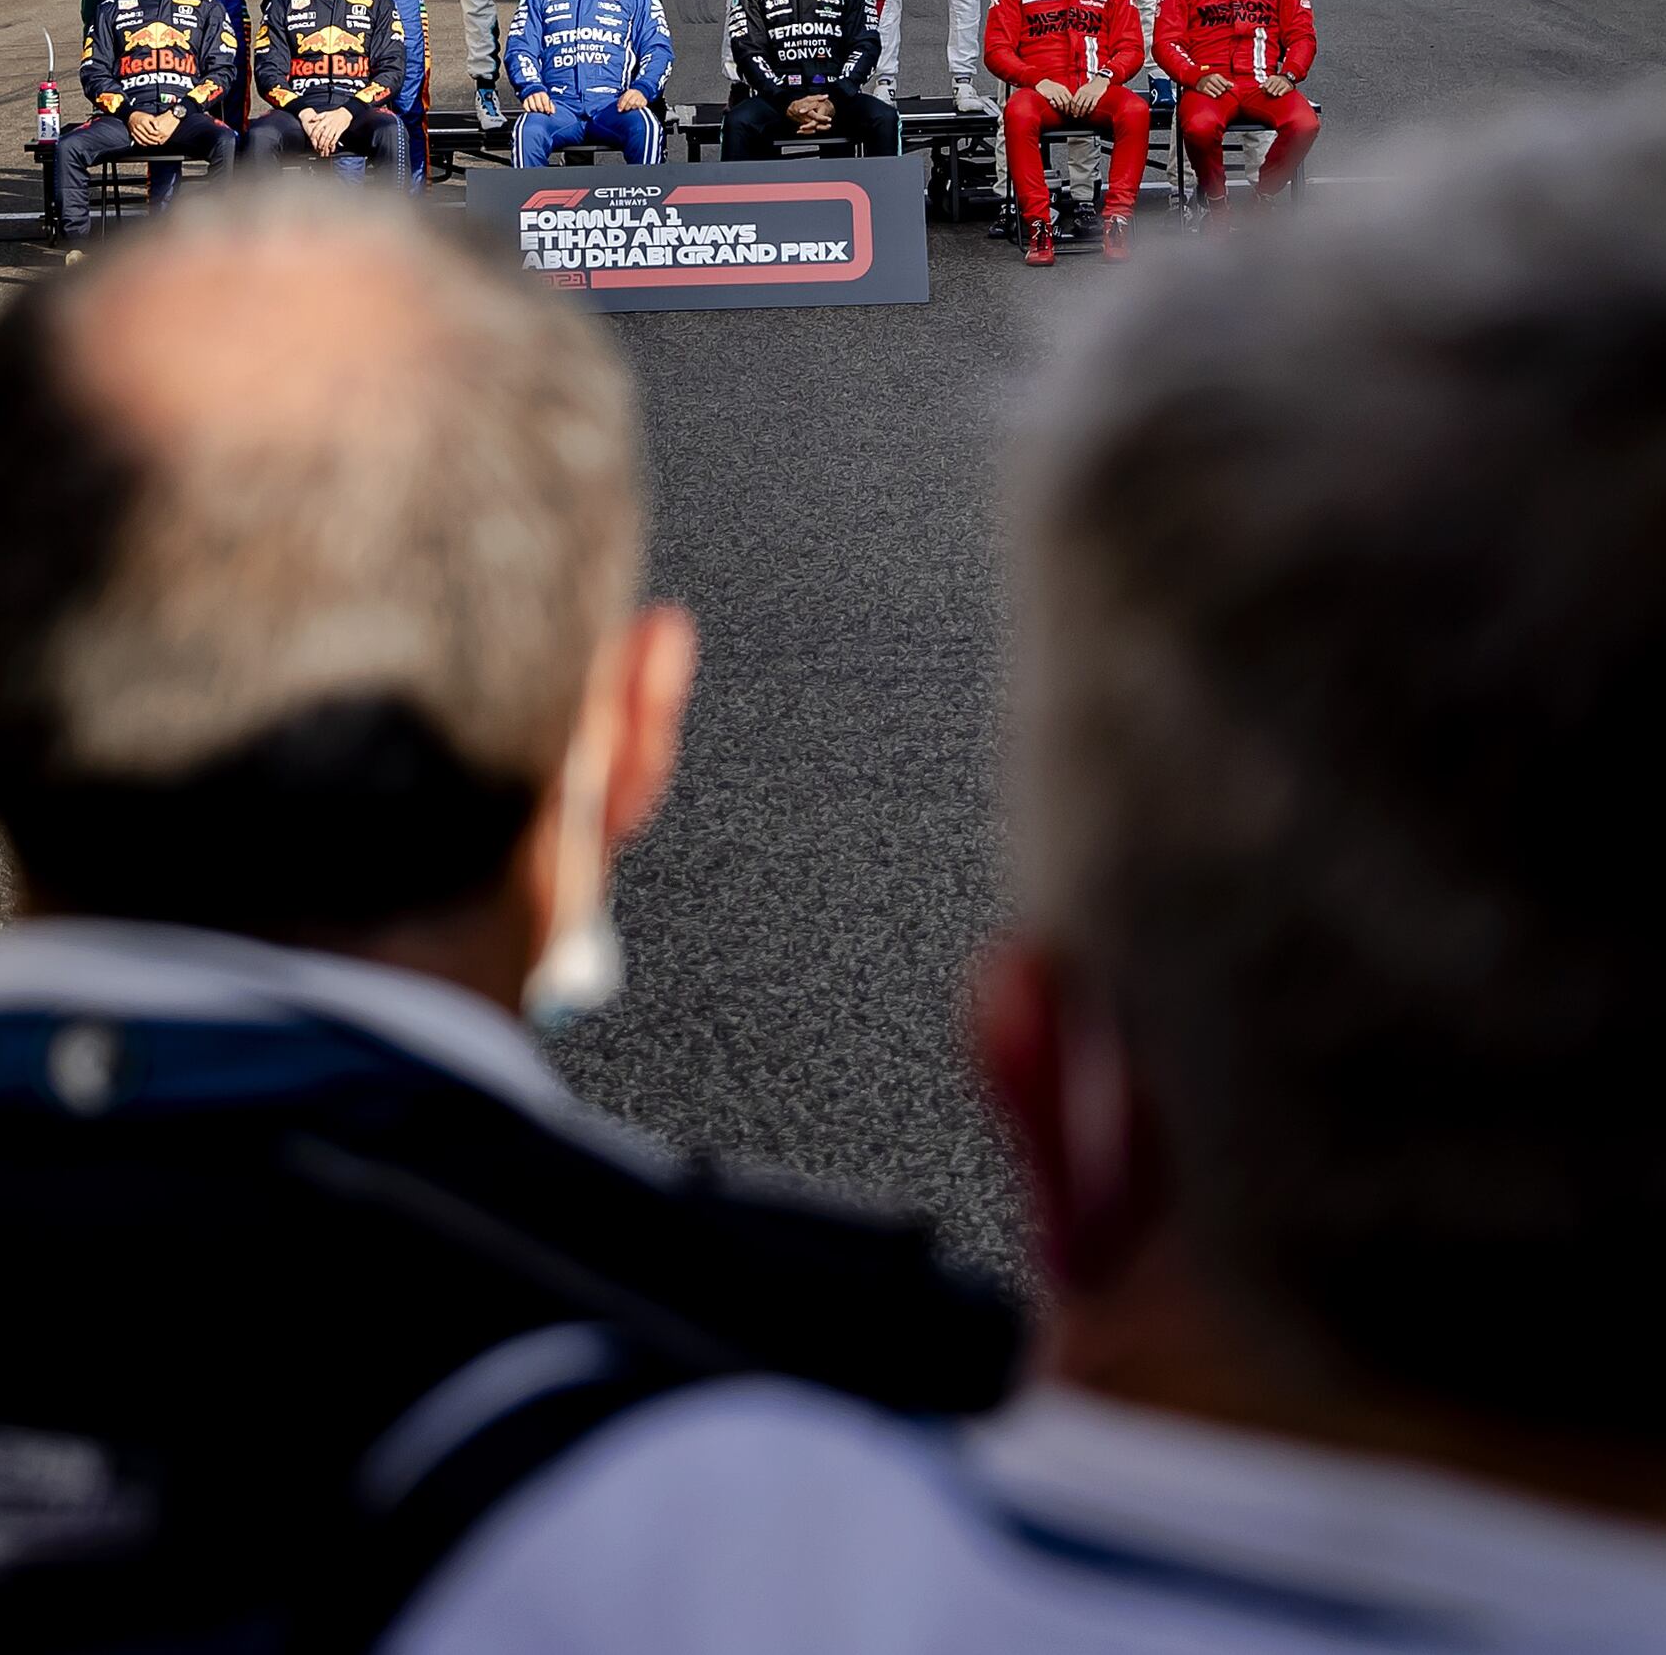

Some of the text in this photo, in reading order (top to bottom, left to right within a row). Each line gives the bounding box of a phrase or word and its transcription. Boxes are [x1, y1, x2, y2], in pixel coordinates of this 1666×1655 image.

[544, 27, 622, 47] PETRONAS
[768, 22, 843, 40] PETRONAS
[784, 39, 827, 49] MARRIOTT
[119, 49, 197, 76] Red Bull
[553, 51, 611, 68] BONVOY
[778, 47, 832, 62] BONVOY
[290, 54, 370, 76] Red Bull
[121, 72, 195, 91] HONDA
[594, 187, 662, 198] ETIHAD
[609, 199, 648, 207] AIRWAYS
[520, 207, 683, 231] FORMULA 1
[520, 224, 757, 251] ETIHAD AIRWAYS
[521, 240, 849, 271] ABU DHABI GRAND PRIX
